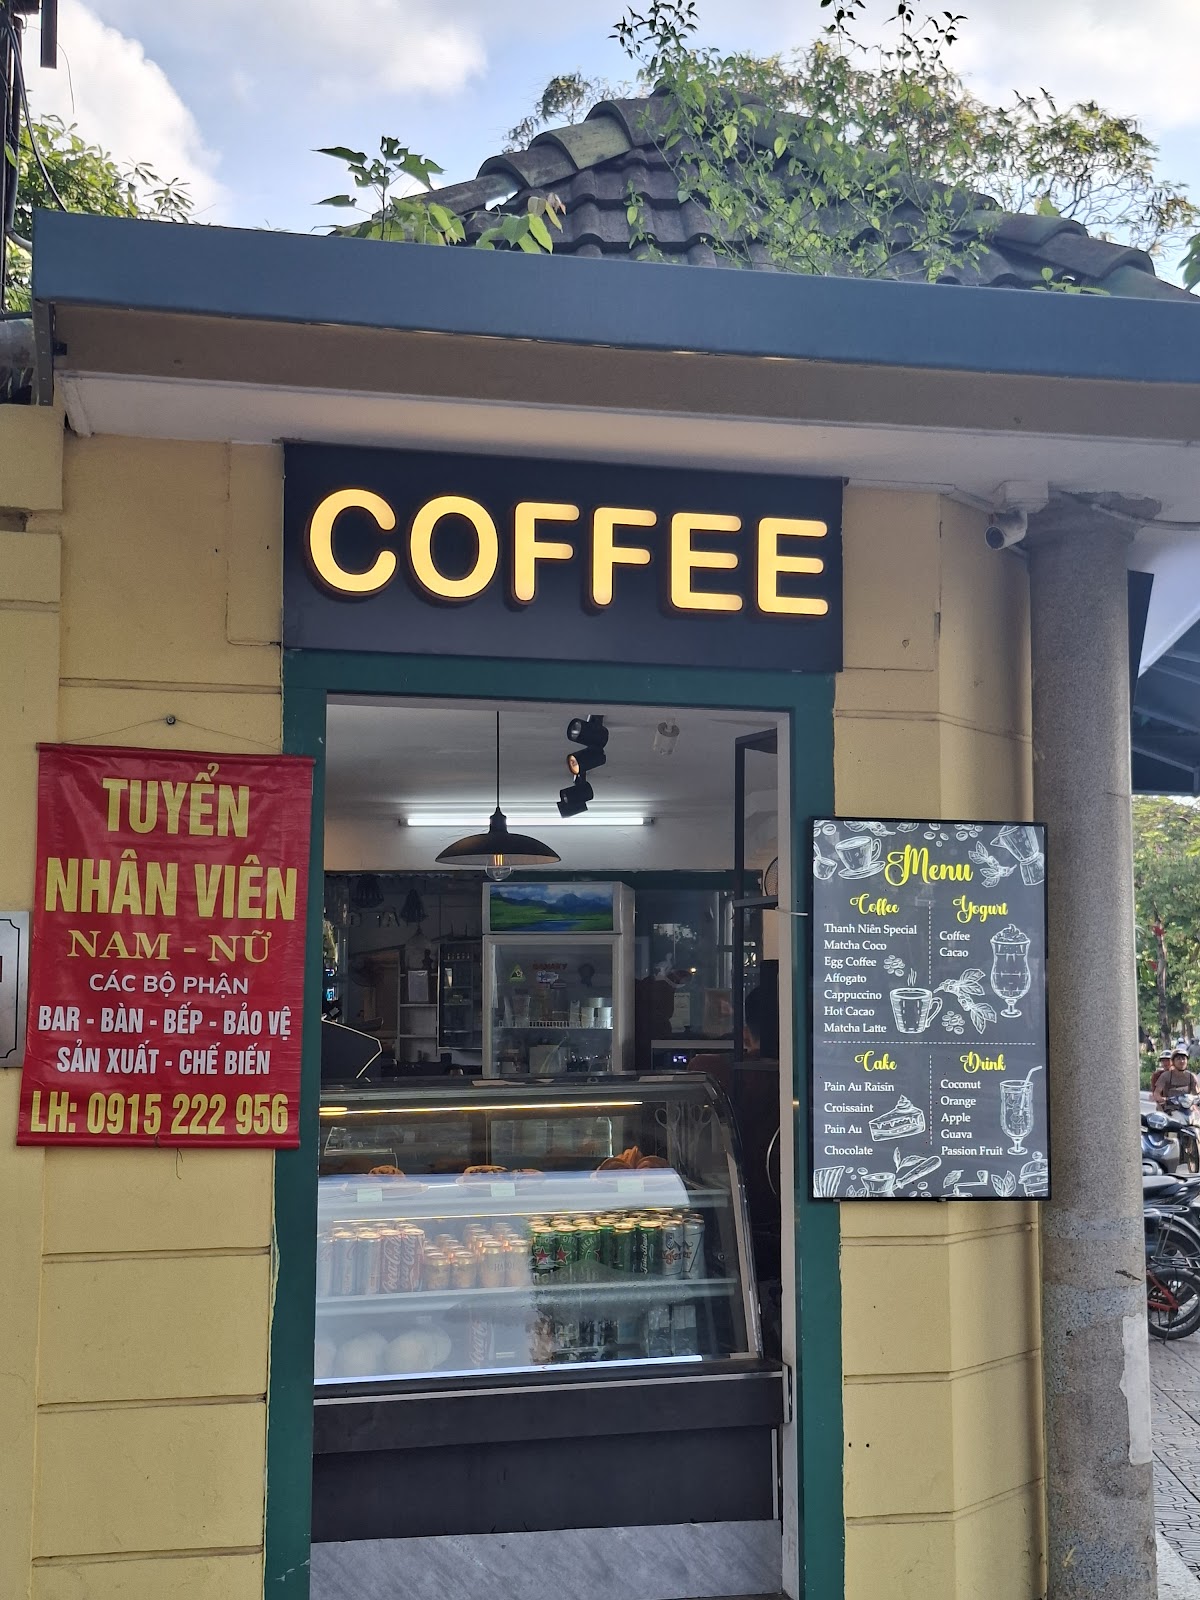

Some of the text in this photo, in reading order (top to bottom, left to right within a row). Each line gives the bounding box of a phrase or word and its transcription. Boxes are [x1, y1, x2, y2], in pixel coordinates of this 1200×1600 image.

[309, 488, 829, 616] COFFEE
[102, 762, 251, 838] TUYỂN
[884, 844, 973, 887] Menu
[45, 849, 298, 920] NHÂN VIÊN
[850, 893, 900, 916] Coffee
[953, 895, 1009, 923] Yogurt
[824, 923, 917, 936] Thanh Niên Special
[939, 931, 971, 941] Coffee
[67, 930, 172, 961] NAM
[208, 930, 273, 963] NỮ
[824, 940, 887, 951] Matcha Coco
[939, 947, 969, 957] Cacao
[824, 957, 877, 968] Egg Coffee
[89, 969, 249, 999] CÁC BỘ PHẬN
[824, 973, 867, 985] Affogato
[824, 990, 882, 1002] Cappuccino
[824, 1007, 875, 1016] Hot Cacao
[38, 1005, 80, 1032] BAR
[101, 1002, 144, 1034] BÀN
[163, 1001, 203, 1034] BẾP
[223, 1002, 262, 1035] BẢO
[269, 1005, 292, 1041] VỆ
[824, 1023, 887, 1033] Matcha Latte
[56, 1038, 100, 1073] SẢN
[106, 1039, 160, 1074] XUẤT
[179, 1041, 218, 1075] CHẾ
[224, 1042, 271, 1075] BIẾN
[854, 1050, 898, 1072] Cake
[959, 1051, 1007, 1074] Drink
[824, 1082, 895, 1092] Pain Au Raisin
[940, 1079, 981, 1090] Coconut
[824, 1103, 874, 1113] Croissaint
[940, 1096, 977, 1108] Orange
[31, 1090, 289, 1136] LH: 0915 222 956
[941, 1113, 971, 1125] Apple
[824, 1124, 863, 1134] Pain Au
[941, 1130, 973, 1140] Guava
[824, 1145, 873, 1156] Chocolate
[941, 1146, 1004, 1156] Passion Fruit
